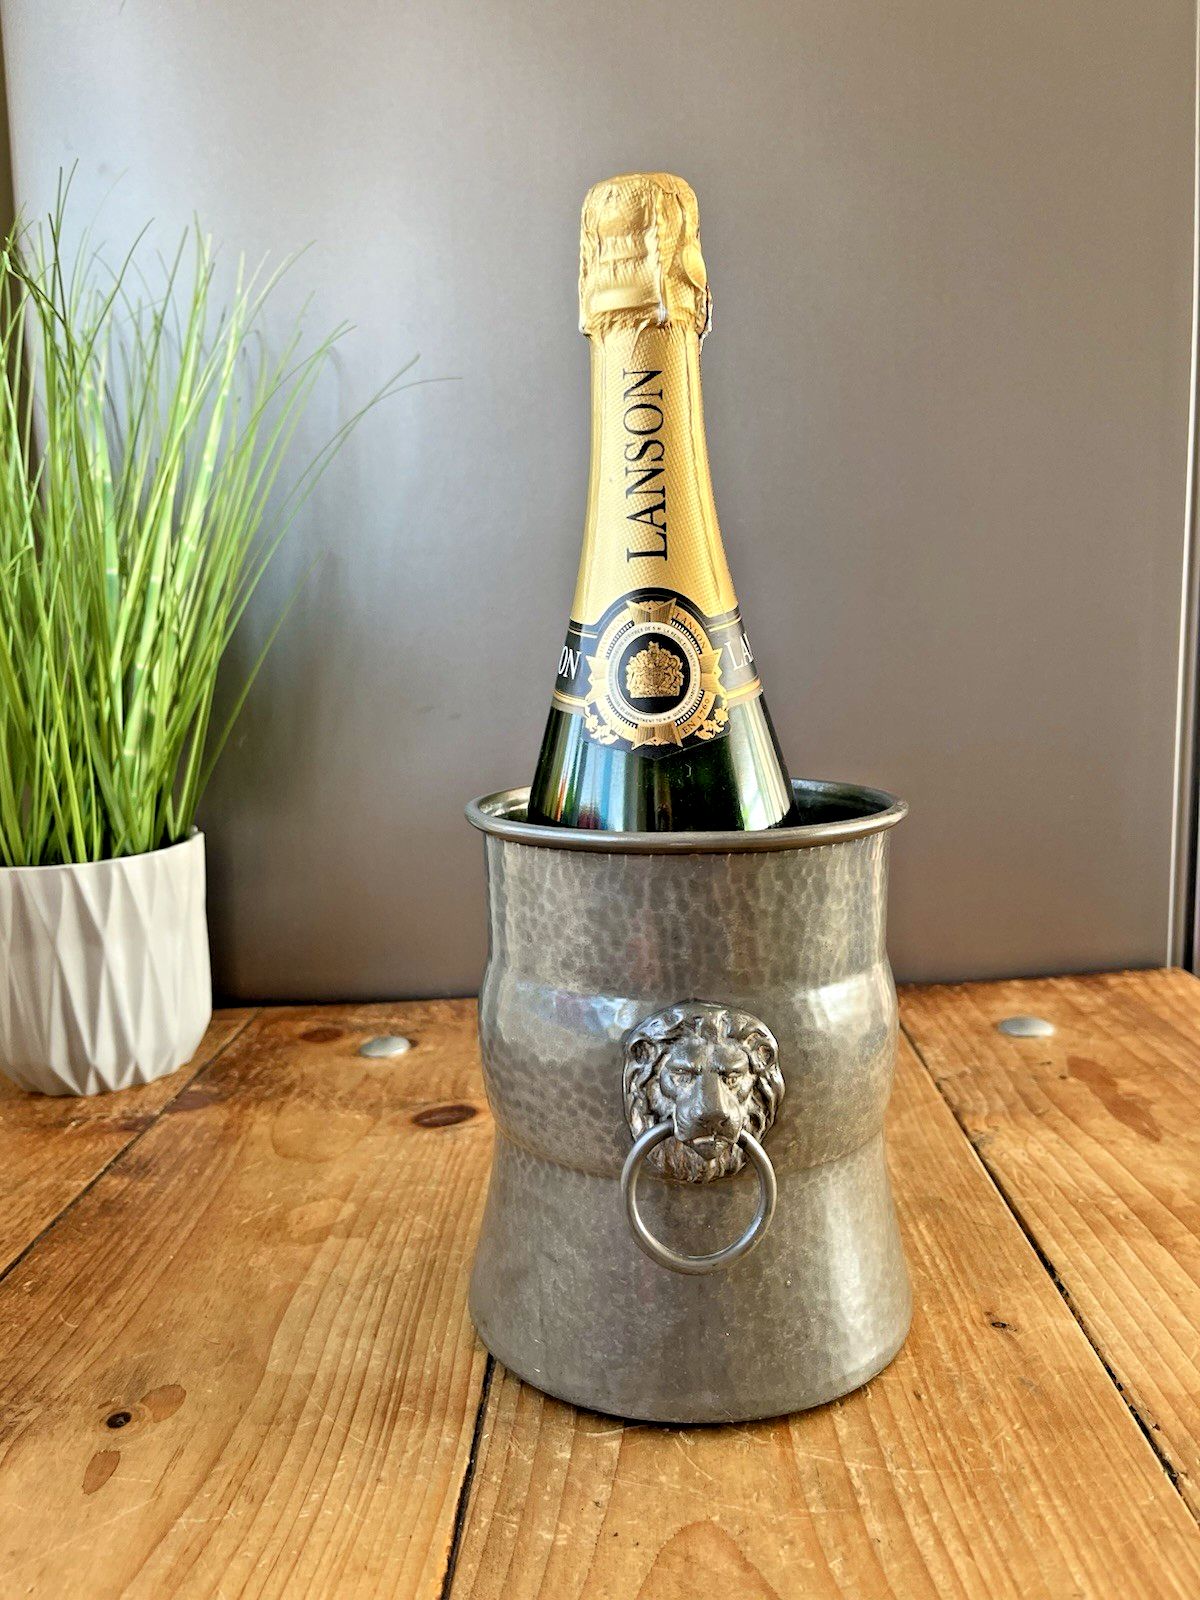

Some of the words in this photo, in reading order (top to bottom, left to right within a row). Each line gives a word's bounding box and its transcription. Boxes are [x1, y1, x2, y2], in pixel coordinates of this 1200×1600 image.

[622, 368, 668, 562] LANSON
[674, 611, 707, 649] LANSON
[558, 645, 582, 680] ON
[682, 720, 698, 734] EN
[697, 698, 710, 720] 1760
